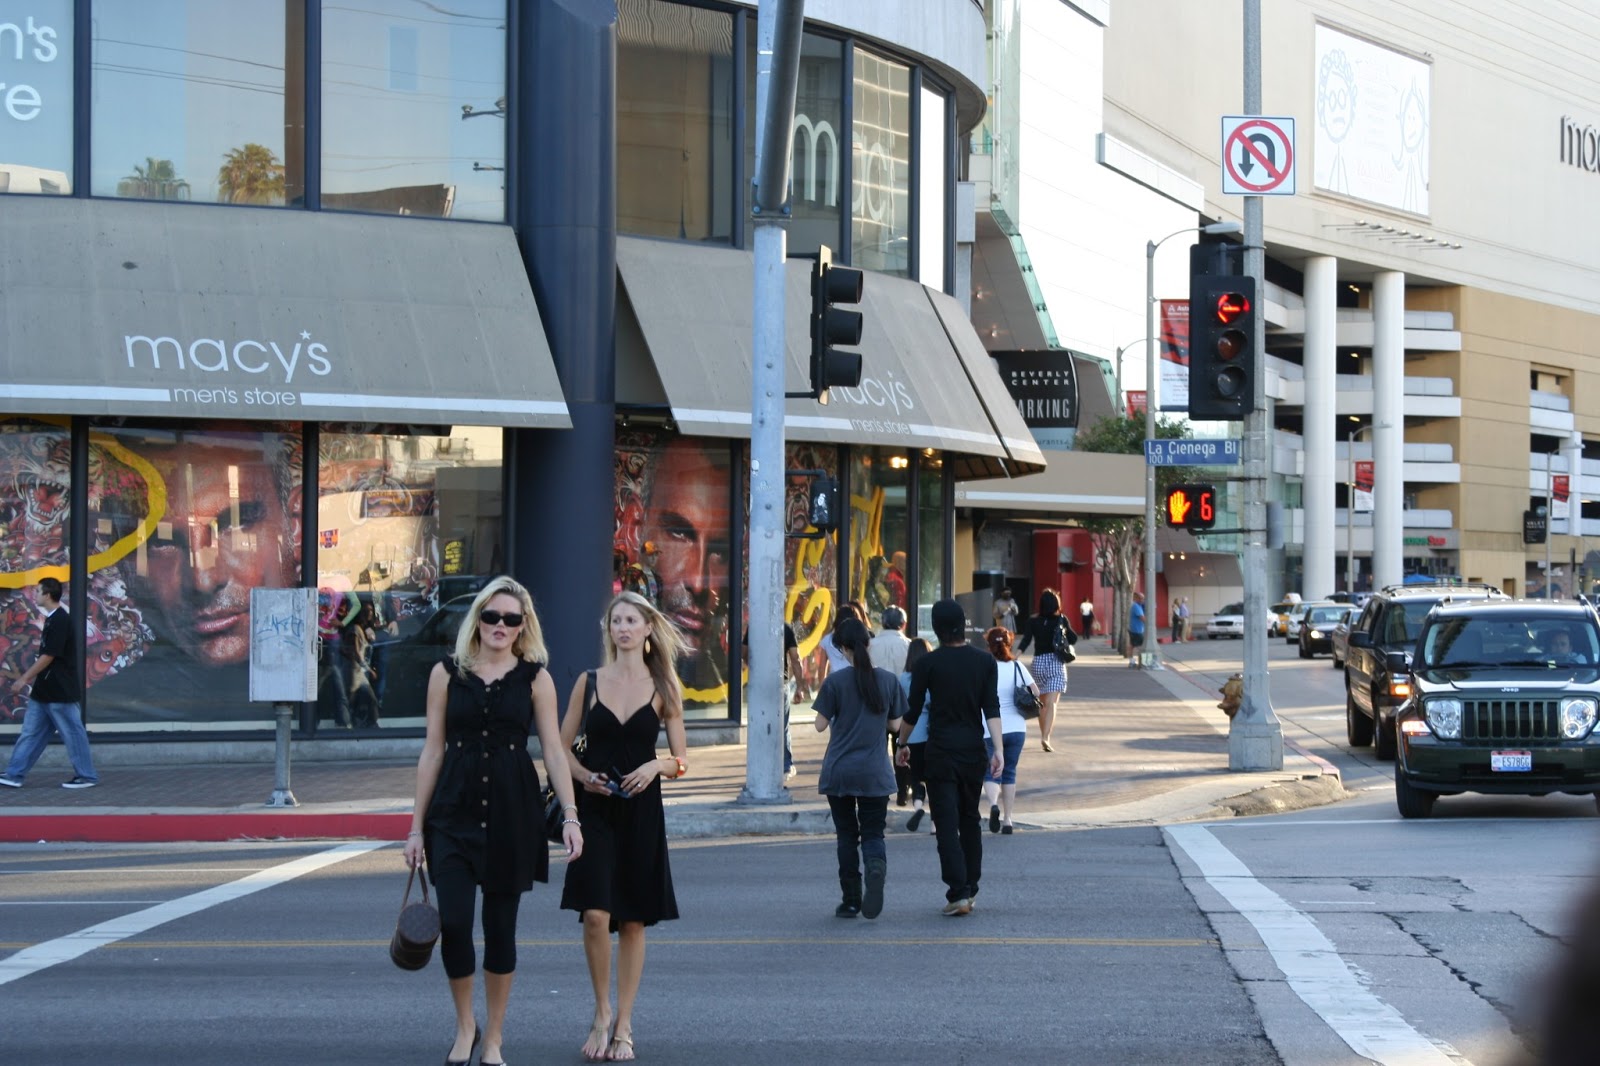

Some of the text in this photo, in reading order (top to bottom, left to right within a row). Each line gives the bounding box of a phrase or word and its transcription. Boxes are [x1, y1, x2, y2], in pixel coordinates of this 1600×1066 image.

[1560, 115, 1600, 175] ma
[1011, 370, 1069, 378] BEVERLY
[174, 386, 296, 406] men's store
[1018, 398, 1070, 419] ARKING
[851, 418, 911, 435] men's store
[1148, 441, 1236, 459] La Cienega Bl
[1149, 455, 1173, 464] 100 N
[1201, 493, 1212, 521] 6
